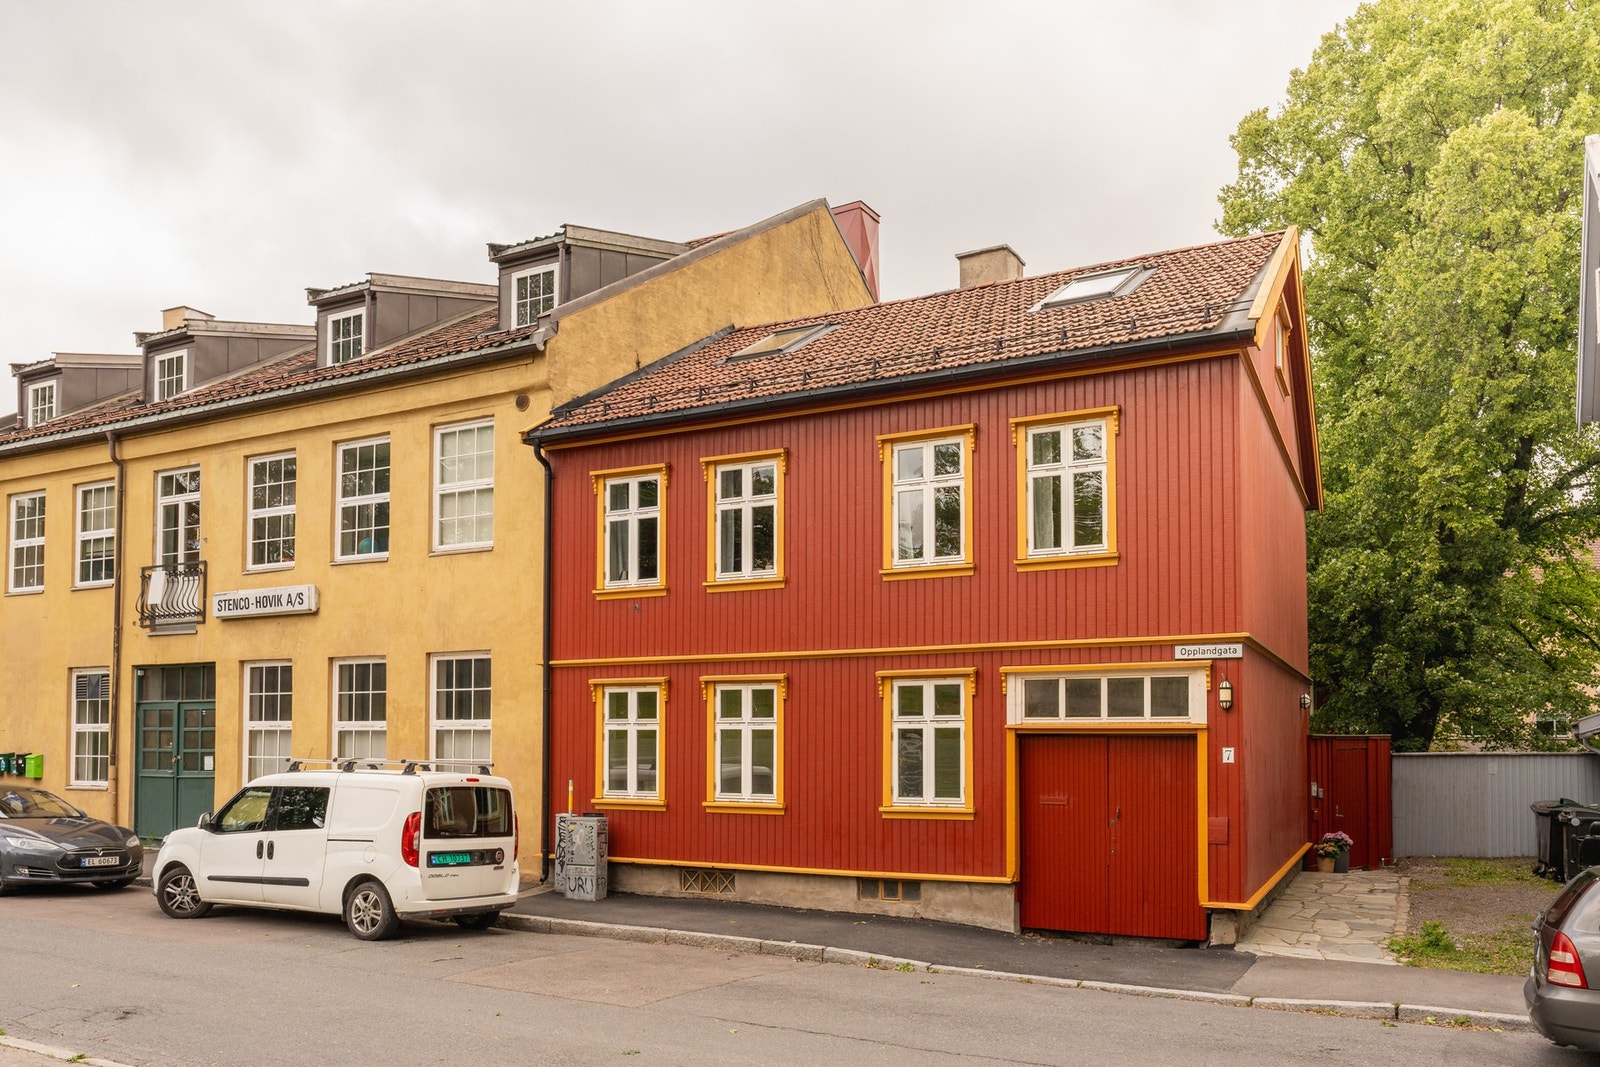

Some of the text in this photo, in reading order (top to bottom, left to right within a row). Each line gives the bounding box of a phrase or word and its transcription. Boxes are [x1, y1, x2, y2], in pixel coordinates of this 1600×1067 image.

[286, 592, 304, 607] A/S
[1180, 647, 1237, 656] Opplandgata
[1225, 750, 1232, 760] 7
[98, 857, 117, 865] 60673
